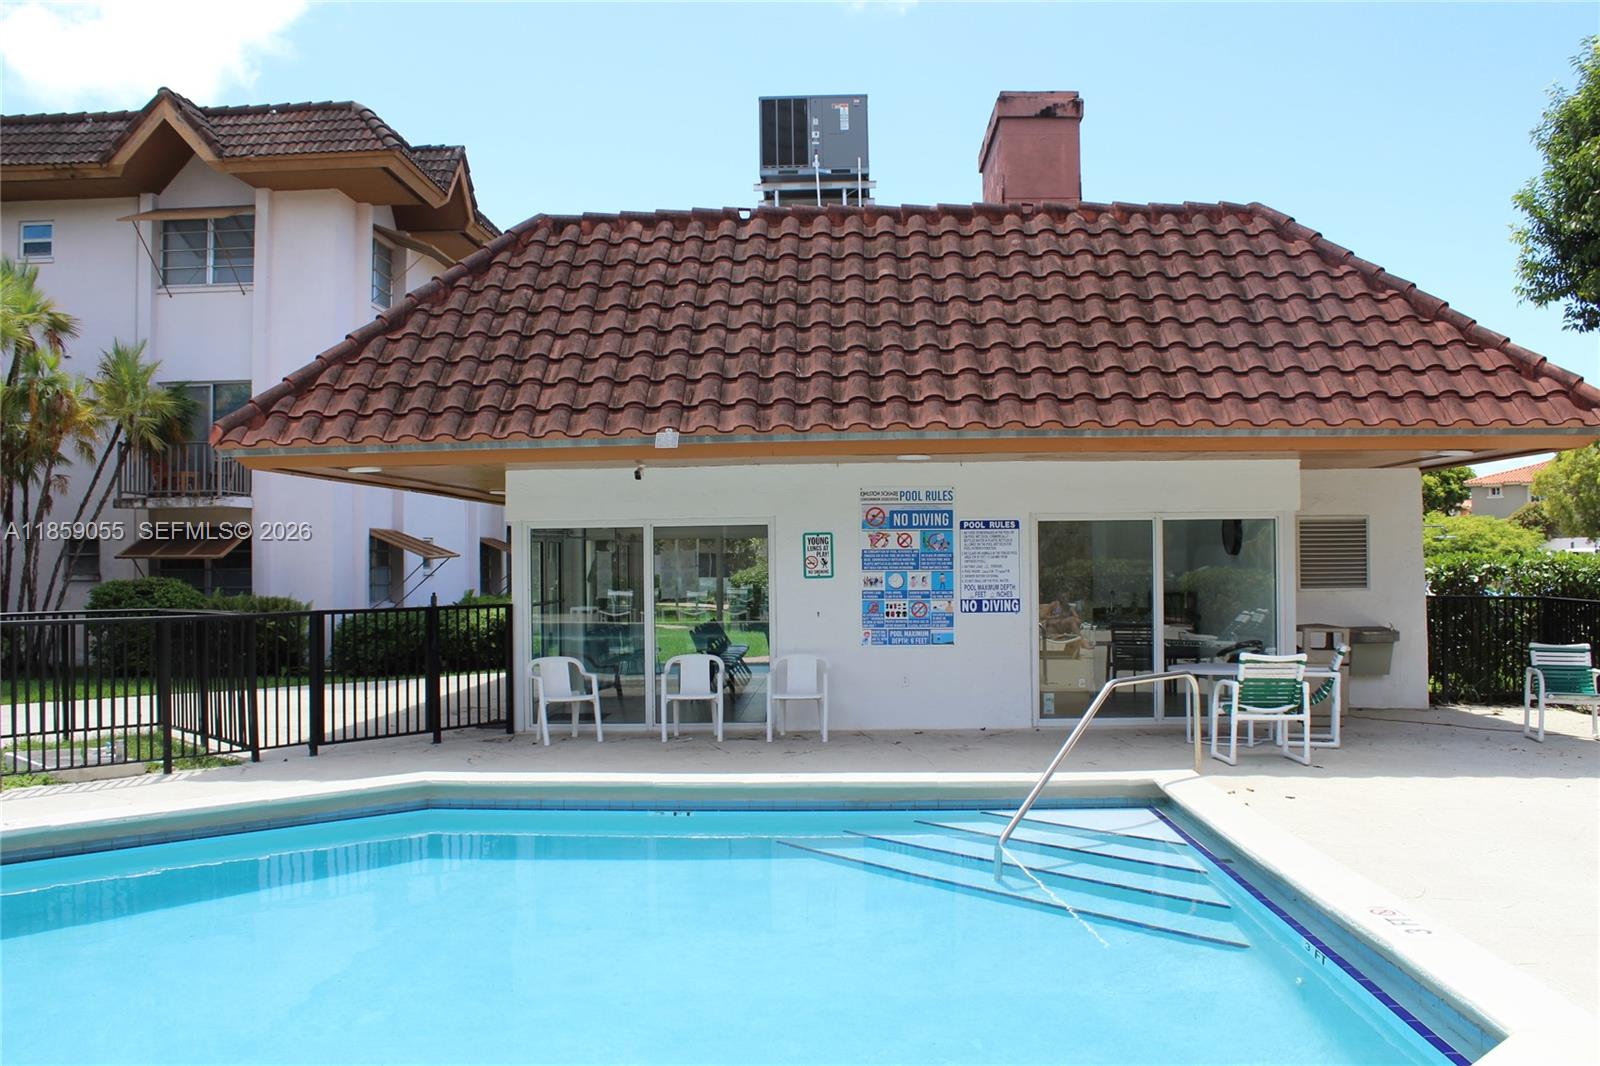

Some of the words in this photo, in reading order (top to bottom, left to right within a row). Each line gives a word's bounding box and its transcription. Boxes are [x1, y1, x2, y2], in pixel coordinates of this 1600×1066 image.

[899, 490, 923, 501] POOL
[925, 490, 953, 501] RULES
[893, 513, 908, 526] NO
[912, 513, 949, 526] DIVING
[963, 521, 985, 529] POOL
[989, 521, 1016, 529] RULES
[807, 537, 829, 545] YOUNG
[962, 600, 977, 612] NO
[982, 600, 1019, 612] DIVING
[1304, 942, 1310, 951] 3
[1314, 949, 1326, 966] FT
